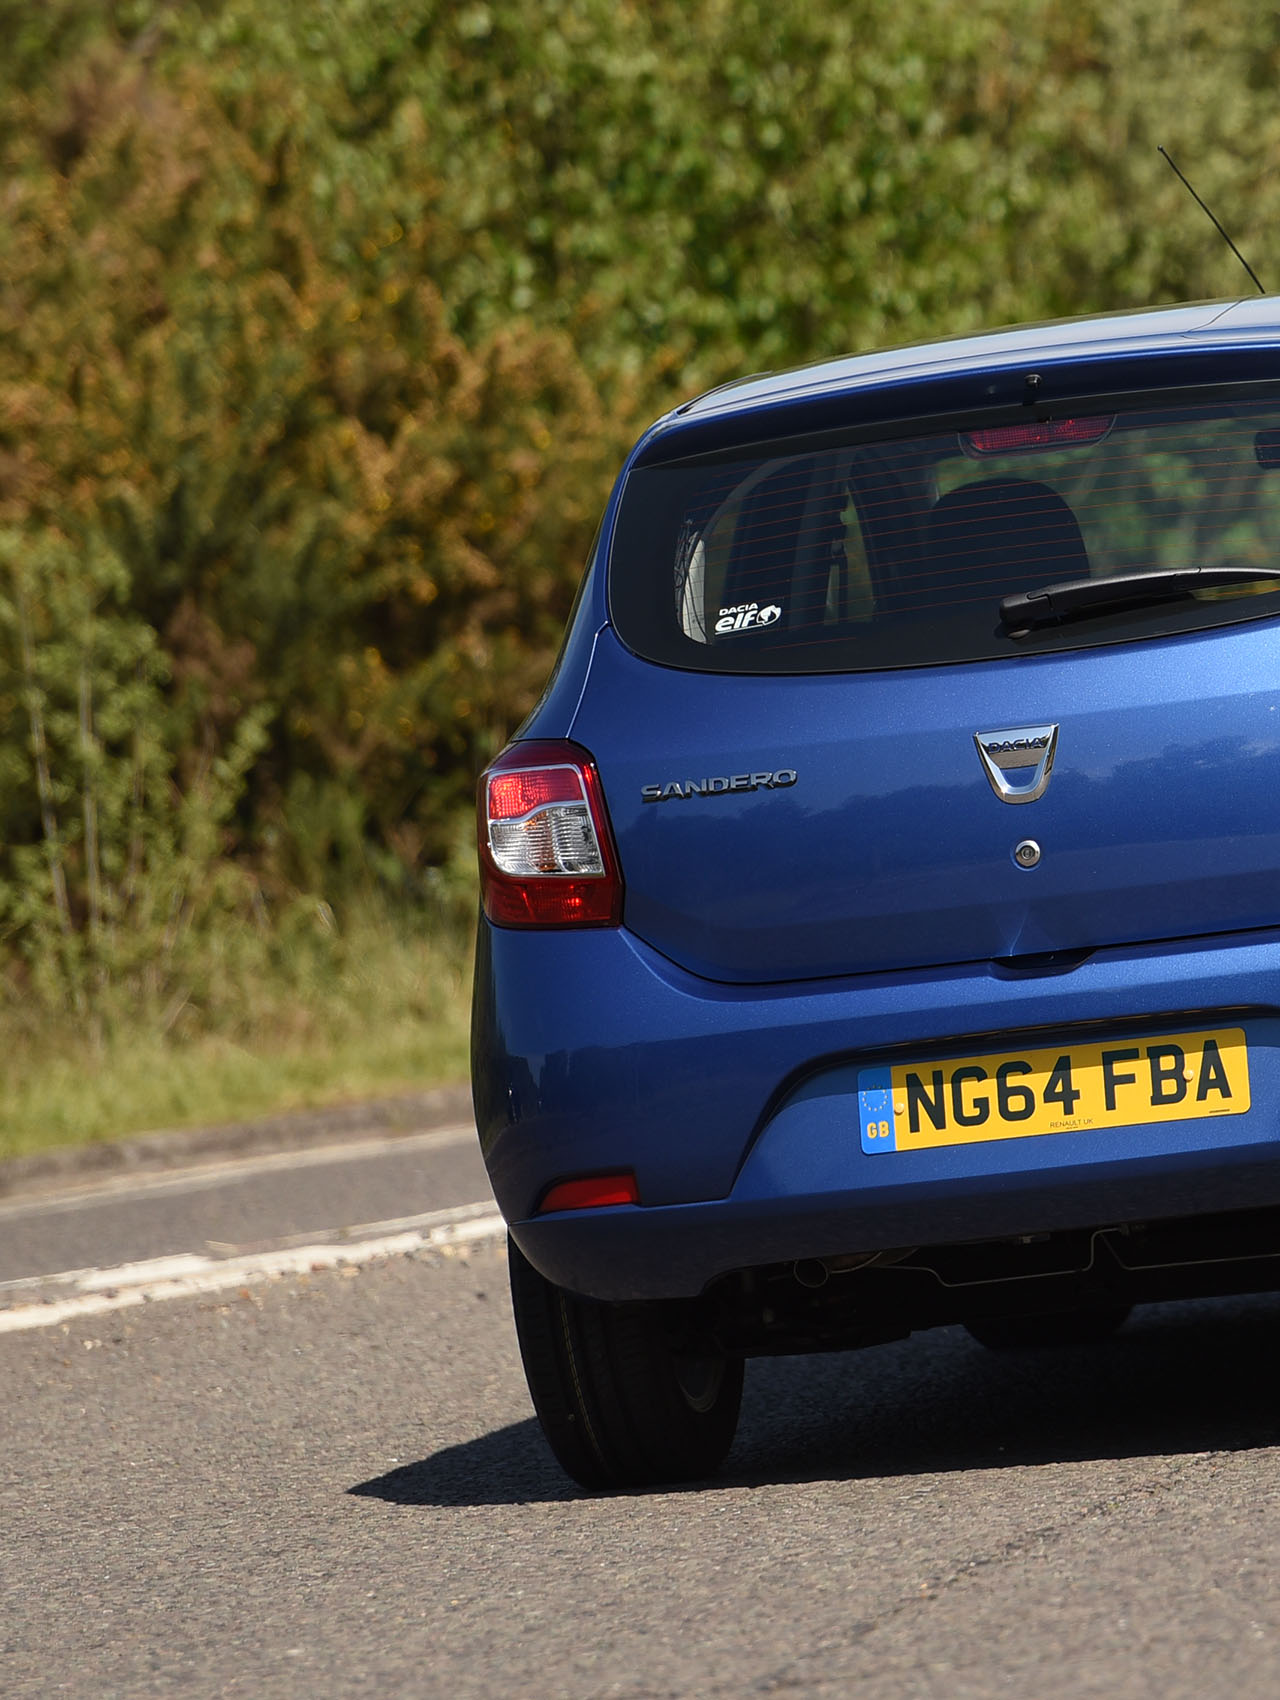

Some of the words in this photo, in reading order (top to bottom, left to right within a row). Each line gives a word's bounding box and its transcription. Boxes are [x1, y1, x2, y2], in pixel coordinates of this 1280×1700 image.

[719, 602, 759, 616] DACIA
[715, 610, 758, 632] elf
[987, 737, 1044, 754] DACIA
[640, 769, 798, 802] SANDERO
[905, 1055, 1081, 1134] NG64
[1101, 1039, 1233, 1111] FBA
[866, 1120, 891, 1139] GB
[1049, 1119, 1081, 1128] RENAULT
